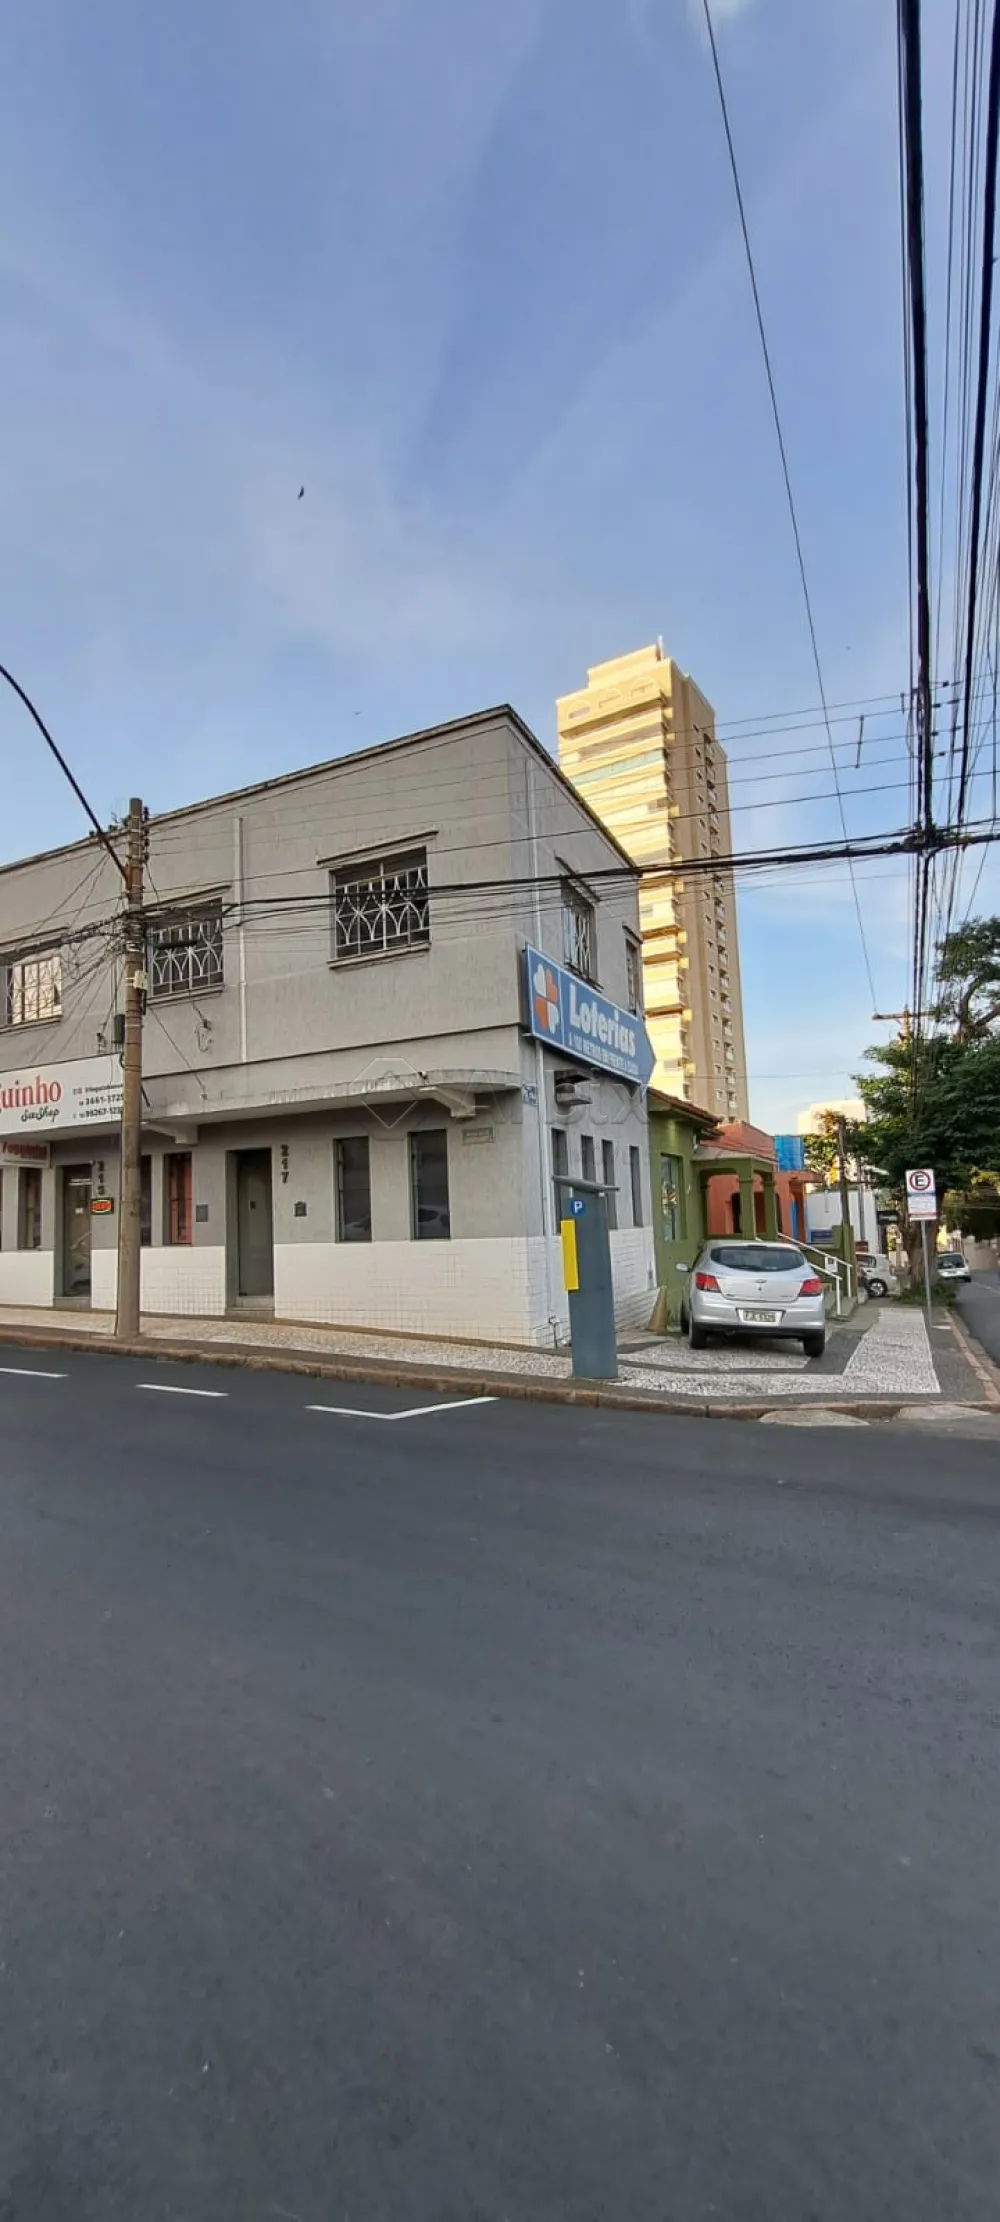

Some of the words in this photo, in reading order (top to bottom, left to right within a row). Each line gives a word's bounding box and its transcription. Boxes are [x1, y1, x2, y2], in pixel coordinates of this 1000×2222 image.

[568, 981, 636, 1058] Loterias
[280, 1143, 290, 1177] 217
[914, 1175, 925, 1186] E
[574, 1201, 583, 1213] P
